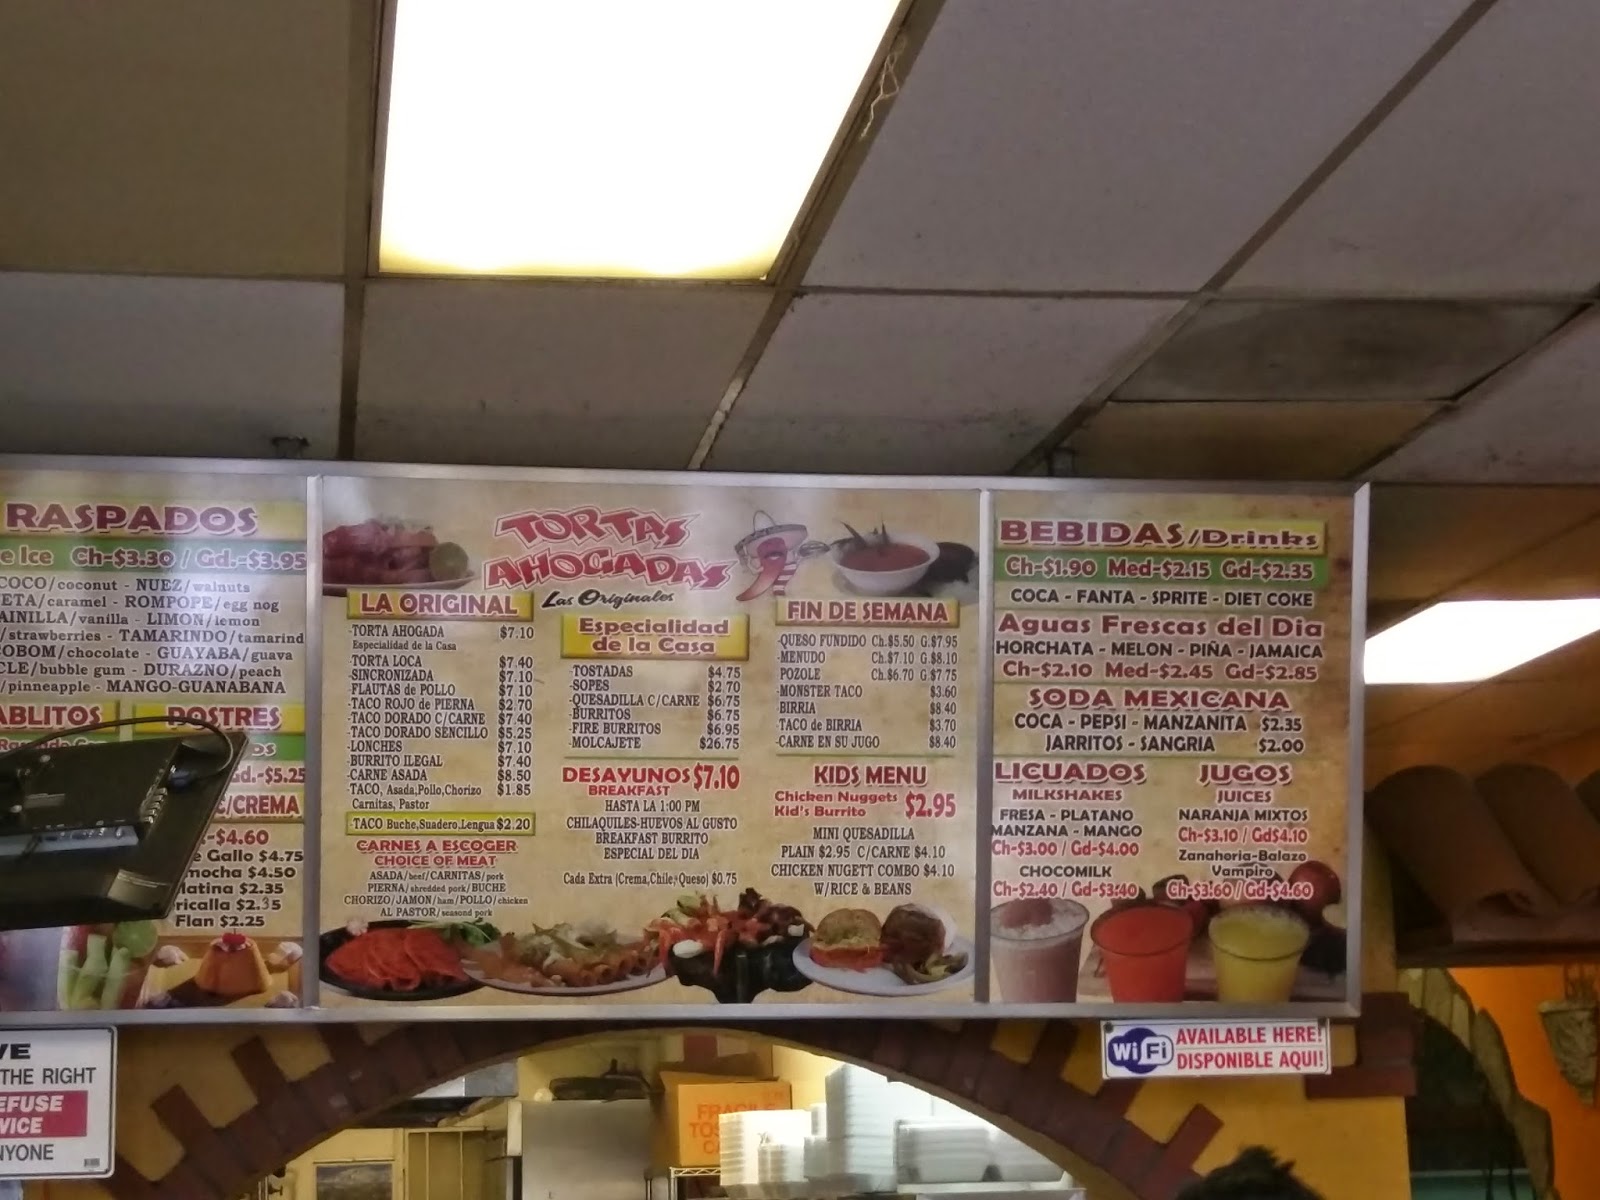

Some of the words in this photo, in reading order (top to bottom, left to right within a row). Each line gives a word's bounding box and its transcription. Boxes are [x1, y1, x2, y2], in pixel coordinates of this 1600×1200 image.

[7, 504, 258, 533] RASPADOS
[501, 507, 687, 546] TORTAS
[20, 547, 52, 564] Ice
[72, 548, 174, 567] Ch-$3.30
[487, 549, 732, 587] AHOGADAS
[1007, 557, 1096, 577] Ch-$1.90
[1108, 559, 1210, 579] Med-$2.15
[1223, 560, 1312, 581] Gd-$2.35
[362, 593, 392, 614] LA
[400, 594, 518, 616] ORIGINAL
[542, 591, 573, 608] Las
[579, 589, 674, 609] Originales
[1011, 590, 1059, 603] COCA
[1077, 590, 1135, 604] FANTA
[1152, 591, 1207, 605] SPRITE
[1224, 593, 1261, 606] DIET
[1267, 593, 1312, 607] COKE
[254, 601, 279, 612] nog
[788, 601, 822, 619] FIN
[829, 602, 856, 620] DE
[863, 602, 948, 621] SEMANA
[392, 626, 444, 637] AHOGADA
[579, 618, 728, 634] Especialidad
[998, 613, 1091, 635] Aguas
[1102, 615, 1207, 635] Frescas
[1218, 617, 1261, 636] del
[1272, 618, 1322, 637] Dia
[352, 642, 408, 651] Especialidad
[592, 637, 621, 651] de
[628, 637, 649, 651] la
[658, 638, 714, 652] Casa
[820, 635, 866, 647] FUNDIDO
[995, 641, 1094, 655] HORCHATA
[1112, 642, 1172, 657] MELON
[1190, 640, 1232, 657] PIÑA
[1250, 644, 1323, 659] JAMAICA
[393, 656, 422, 667] LOCA
[94, 666, 125, 677] gum
[499, 670, 533, 683] $7.10
[780, 668, 820, 680] POZOLE
[1003, 661, 1093, 680] Ch-$2.10
[1106, 663, 1213, 681] Med-$2.45
[1225, 664, 1318, 682] Gd-$2.85
[420, 685, 455, 696] POLLO
[835, 685, 862, 698] TACO
[386, 698, 414, 710] ROJO
[434, 699, 474, 710] PIERNA
[1030, 689, 1111, 709] SODA
[1125, 689, 1290, 710] MEXICANA
[168, 706, 280, 726] POSTRES
[384, 712, 431, 724] DORADO
[707, 708, 740, 722] $6.75
[603, 723, 661, 734] BURRITOS
[826, 719, 862, 731] BIRRIA
[1015, 714, 1063, 729] COCA
[1080, 714, 1127, 730] PEPSI
[1144, 715, 1247, 732] MANZANITA
[1261, 717, 1302, 732] $2.35
[384, 727, 431, 738] DORADO
[435, 727, 488, 739] SENCILLO
[498, 741, 532, 754] $7.10
[851, 736, 879, 748] JUGO
[929, 735, 956, 749] $8.40
[1046, 735, 1123, 752] JARRITOS
[1140, 737, 1215, 752] SANGRIA
[1259, 738, 1304, 754] $2.00
[404, 755, 443, 767] ILEGAL
[391, 770, 427, 781] ASADA
[562, 767, 690, 783] DESAYUNOS
[694, 763, 739, 791] $7.10
[814, 766, 859, 785] KIDS
[866, 766, 927, 786] MENU
[995, 763, 1145, 784] LICUADOS
[1200, 764, 1291, 785] JUGOS
[497, 783, 531, 796] $1.85
[589, 786, 670, 796] BREAKFAST
[1012, 789, 1122, 801] MILKSHAKES
[1217, 790, 1272, 804] JUICES
[399, 799, 429, 809] Pastor
[605, 800, 639, 812] HASTA
[660, 800, 681, 812] 1:00
[685, 801, 700, 812] PM
[775, 791, 832, 802] Chicken
[838, 792, 897, 804] Nuggets
[906, 791, 956, 819] $2.95
[775, 806, 809, 816] Kid's
[814, 806, 866, 817] Burrito
[1000, 809, 1045, 820] FRESA
[1061, 810, 1133, 821] PLATANO
[1179, 809, 1250, 822] NARANJA
[1254, 810, 1308, 821] MIXTOS
[702, 818, 737, 829] GUSTO
[813, 827, 838, 839] MINI
[843, 827, 914, 842] QUESADILLA
[992, 825, 1068, 836] MANZANA
[1084, 826, 1142, 837] MANGO
[596, 832, 658, 844] BREAKFAST
[662, 833, 708, 844] BURRITO
[357, 840, 421, 852] CARNES
[442, 840, 517, 852] ESCOGER
[781, 845, 814, 858] PLAIN
[914, 845, 945, 859] $4.10
[207, 850, 253, 862] Gallo
[259, 850, 303, 863] $4.75
[604, 848, 654, 859] ESPECIAL
[681, 848, 699, 859] DIA
[375, 856, 429, 866] CHOICE
[434, 856, 451, 866] OF
[457, 856, 496, 866] MEAT
[248, 866, 296, 879] $4.50
[771, 864, 823, 877] CHICKEN
[828, 864, 874, 876] NUGETT
[878, 864, 919, 876] COMBO
[923, 864, 954, 878] $4.10
[1020, 866, 1111, 877] CHOCOMILK
[1212, 865, 1273, 878] Vampiro
[564, 873, 585, 884] Cada
[589, 873, 612, 884] Extra
[712, 872, 737, 885] $0.75
[240, 883, 283, 894] $2.35
[874, 882, 911, 895] BEANS
[176, 915, 214, 926] Flan
[220, 915, 264, 927] $2.25
[1176, 1027, 1266, 1044] AVAILABLE
[1273, 1026, 1322, 1043] HERE!
[1178, 1052, 1272, 1069] DISPONIBLE
[1279, 1051, 1323, 1070] AQUI!
[2, 1069, 33, 1084] THE
[43, 1068, 96, 1084] RIGHT
